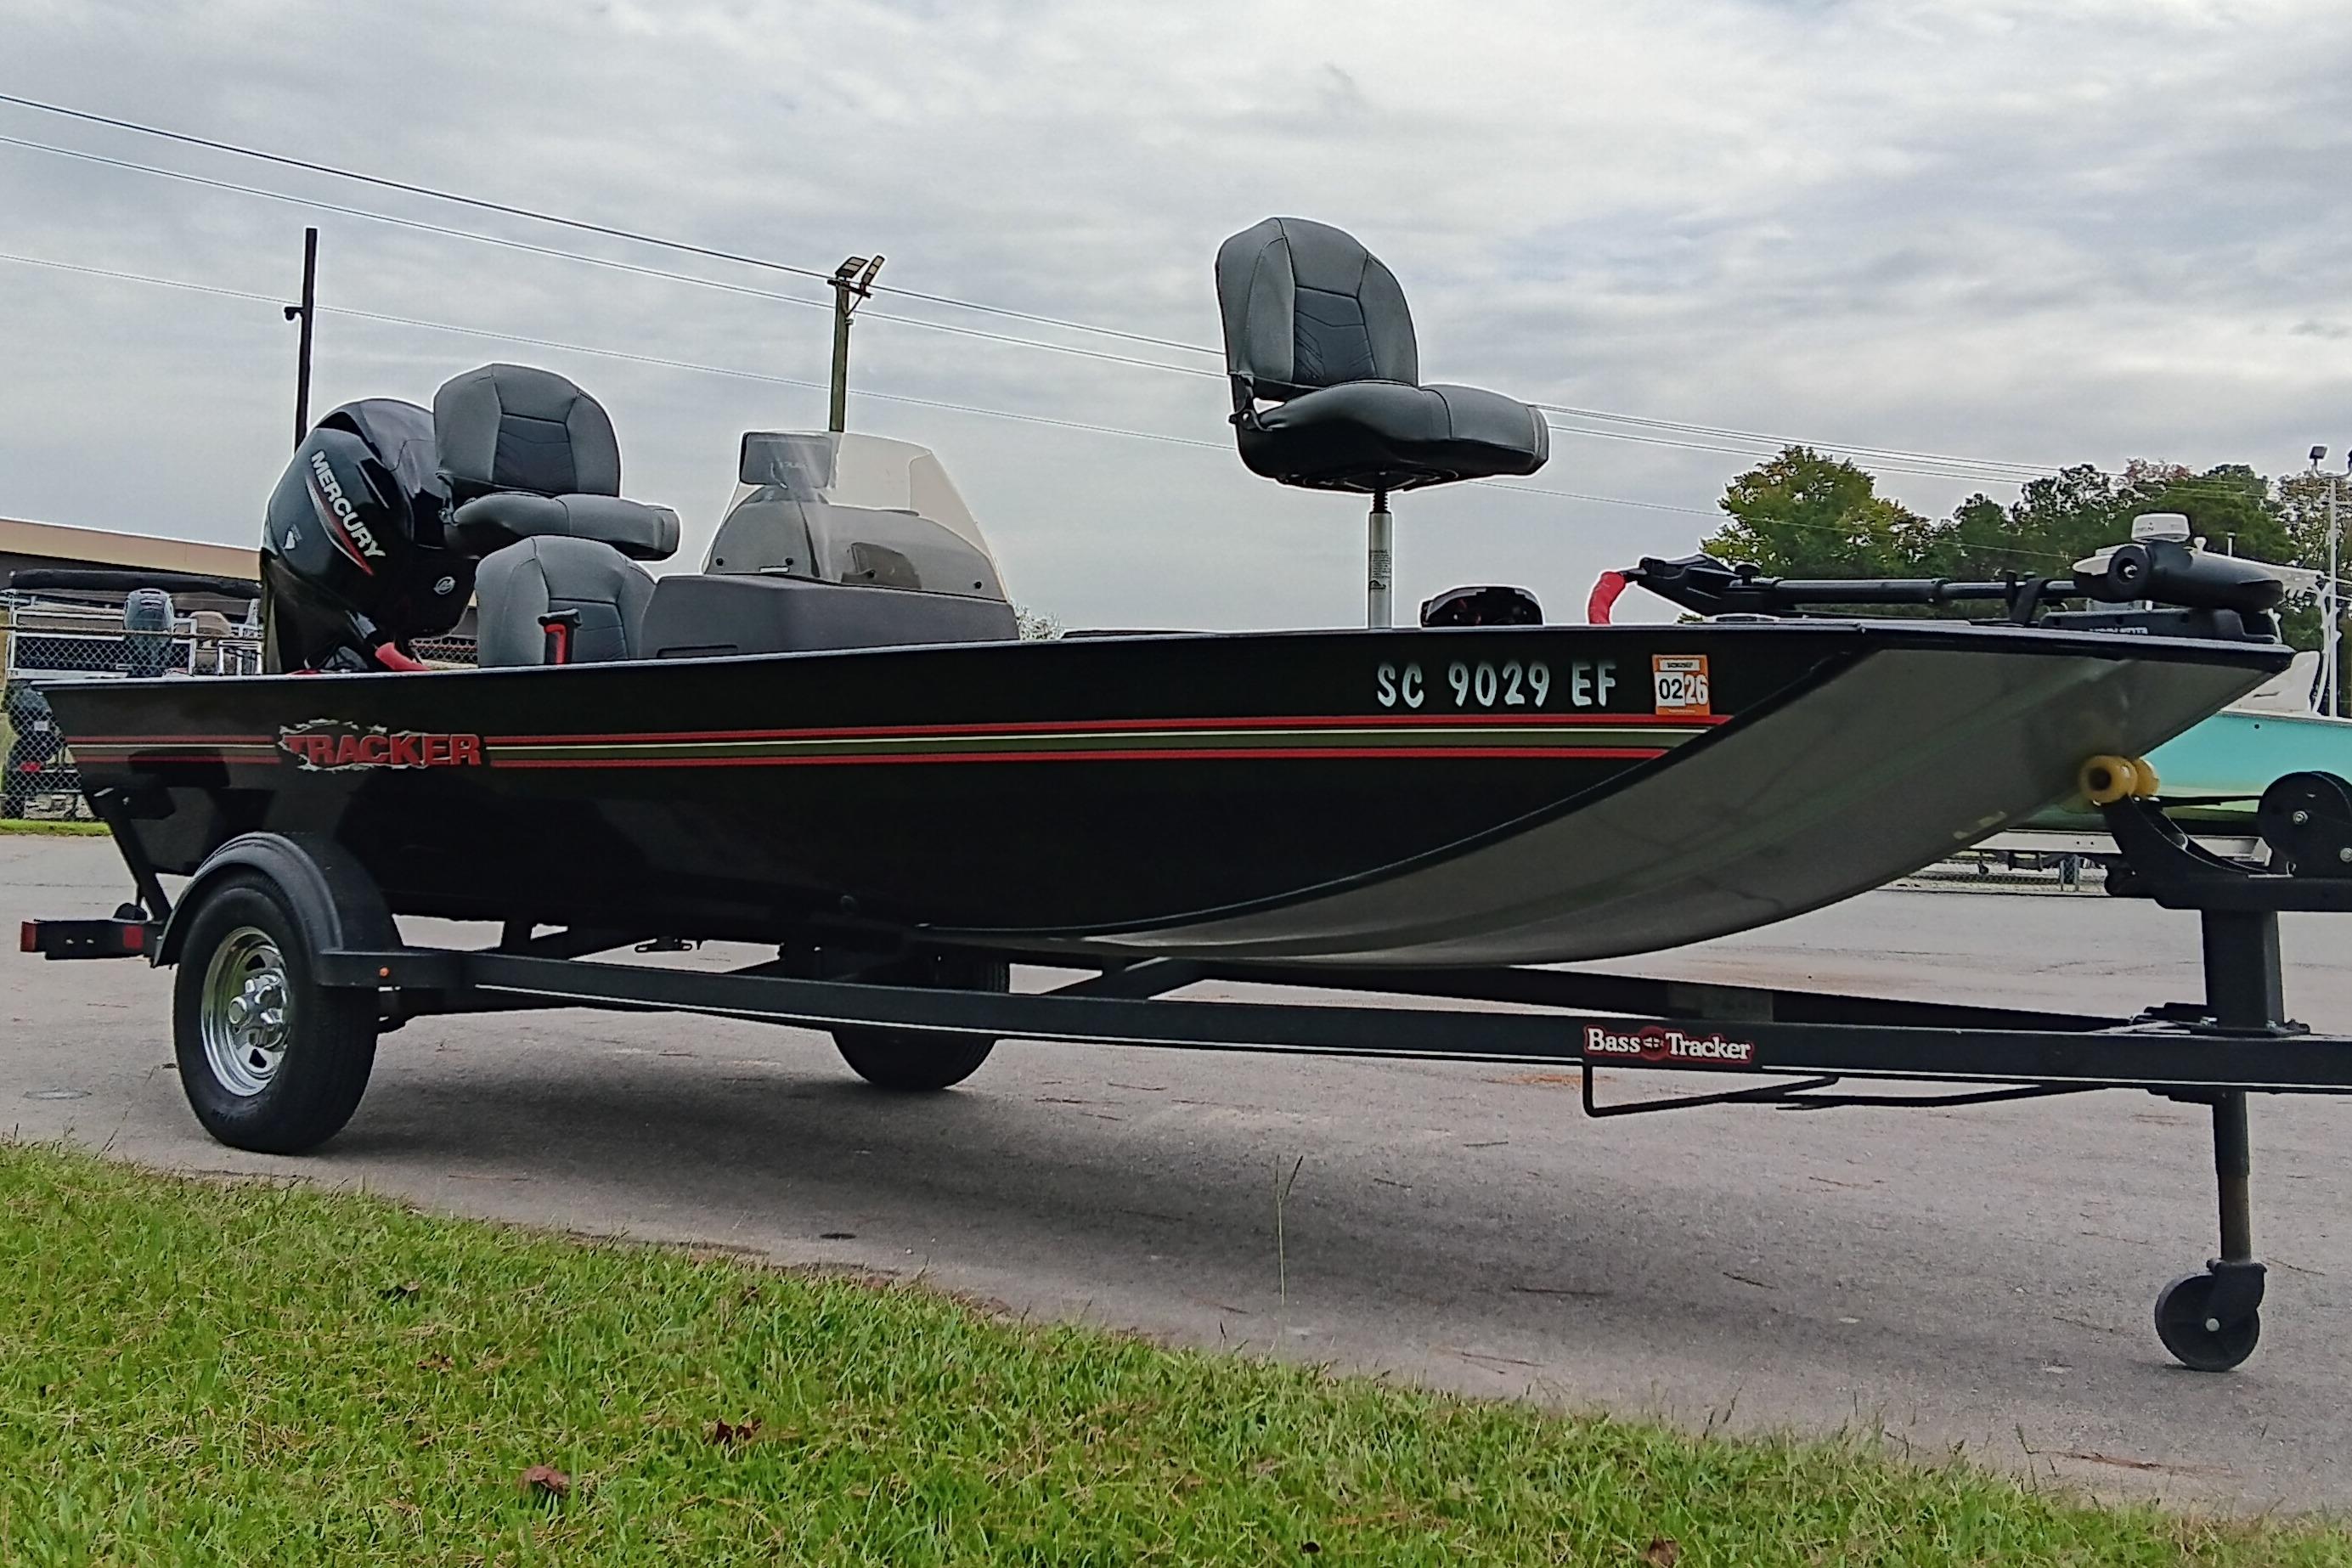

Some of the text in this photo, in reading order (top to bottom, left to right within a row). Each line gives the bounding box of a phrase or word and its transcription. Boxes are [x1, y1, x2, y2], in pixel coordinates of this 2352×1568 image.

[311, 450, 386, 557] MERCURY
[1377, 660, 1616, 708] SC 9029 EF
[1659, 674, 1708, 705] 02 26
[283, 733, 482, 765] TRACKER
[1587, 1028, 1751, 1060] Bass Tracker
